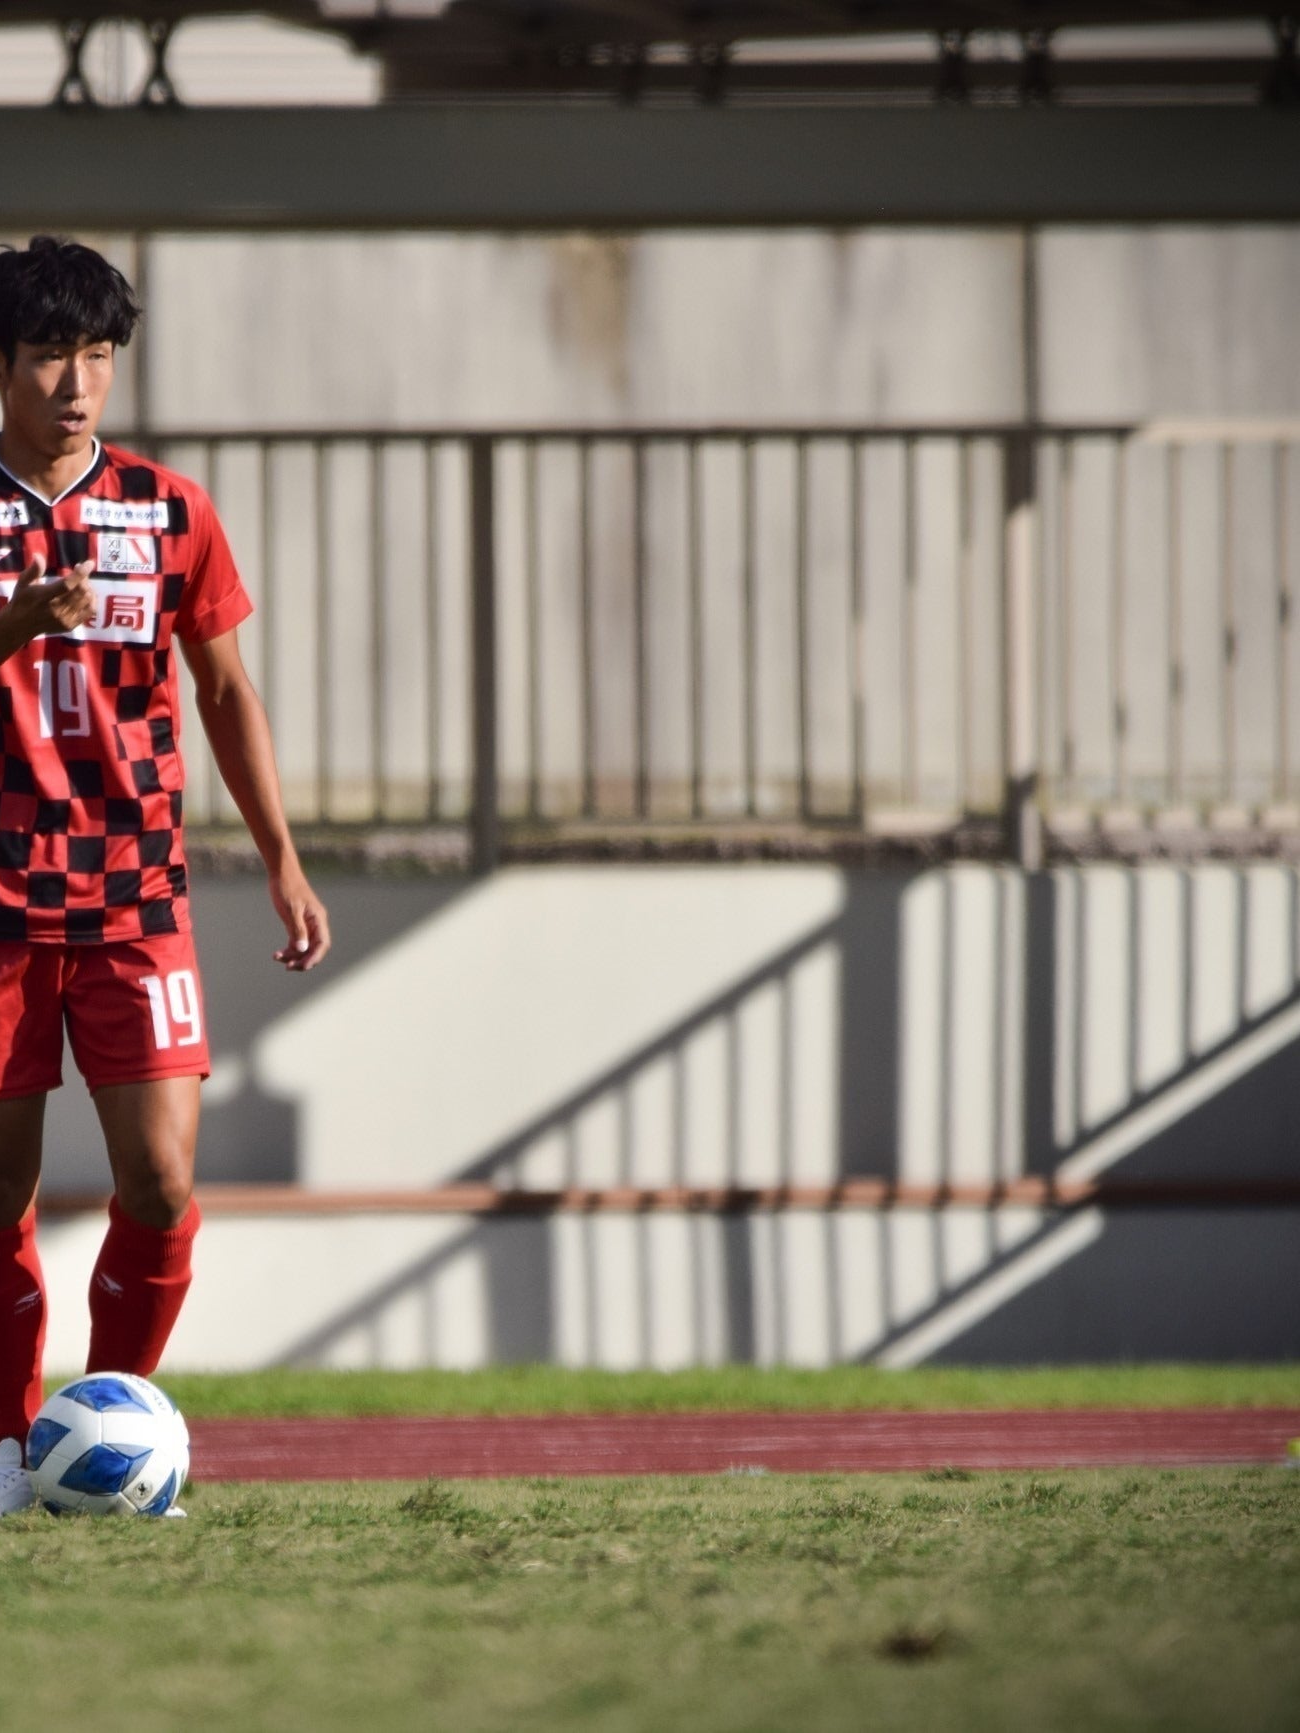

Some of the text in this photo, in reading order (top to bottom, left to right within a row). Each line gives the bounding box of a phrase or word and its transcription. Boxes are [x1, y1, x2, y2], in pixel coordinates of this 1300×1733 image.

[115, 564, 152, 572] KARIYA
[33, 659, 91, 739] 19
[138, 969, 202, 1050] 19
